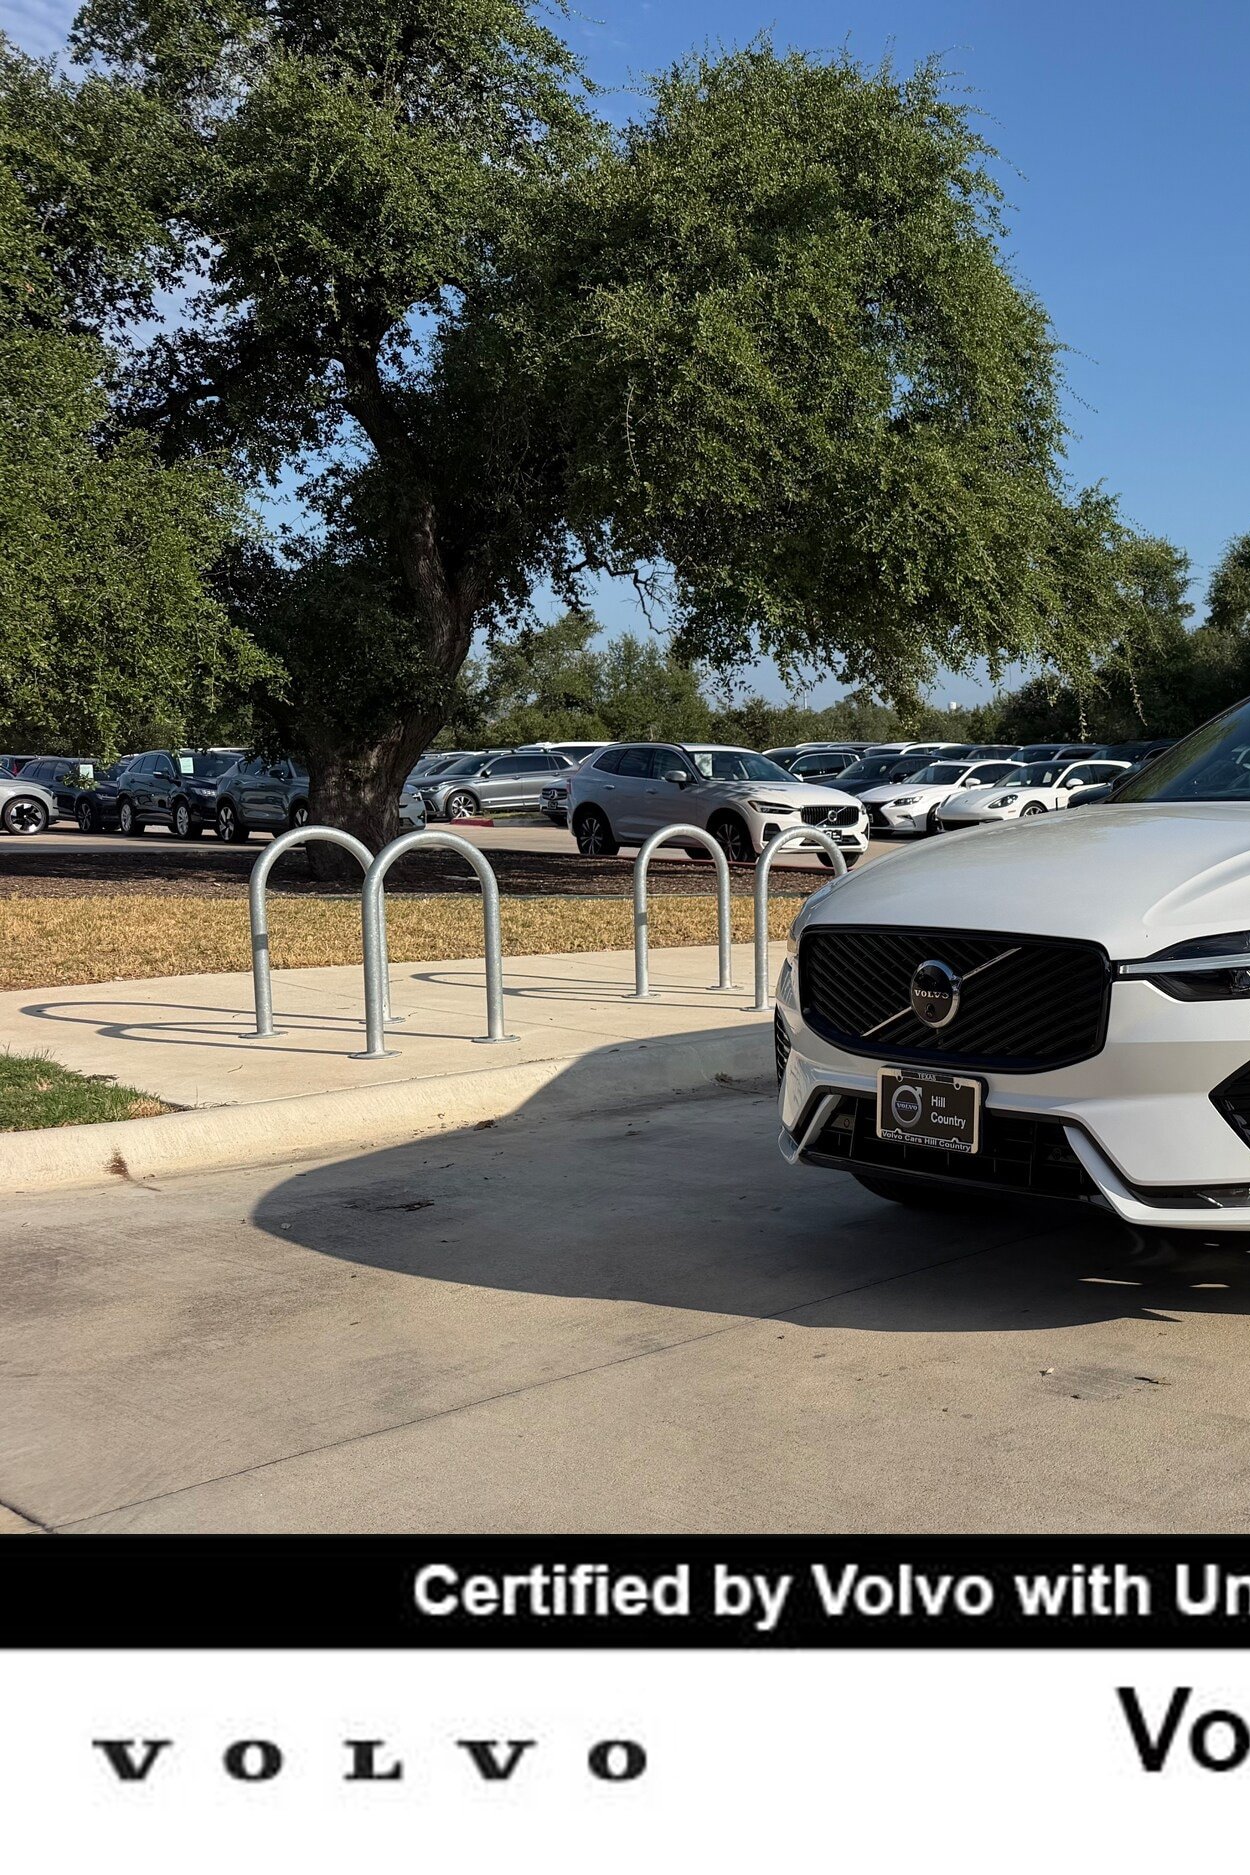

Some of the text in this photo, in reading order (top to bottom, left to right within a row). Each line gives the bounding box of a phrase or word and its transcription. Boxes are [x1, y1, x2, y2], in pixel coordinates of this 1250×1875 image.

[914, 989, 949, 999] VOLVO
[918, 1073, 936, 1081] TEXAS
[896, 1102, 918, 1111] VOLVO
[931, 1095, 946, 1108] Hill
[930, 1111, 966, 1130] Country
[882, 1130, 971, 1152] Volvo Cars Hill Country
